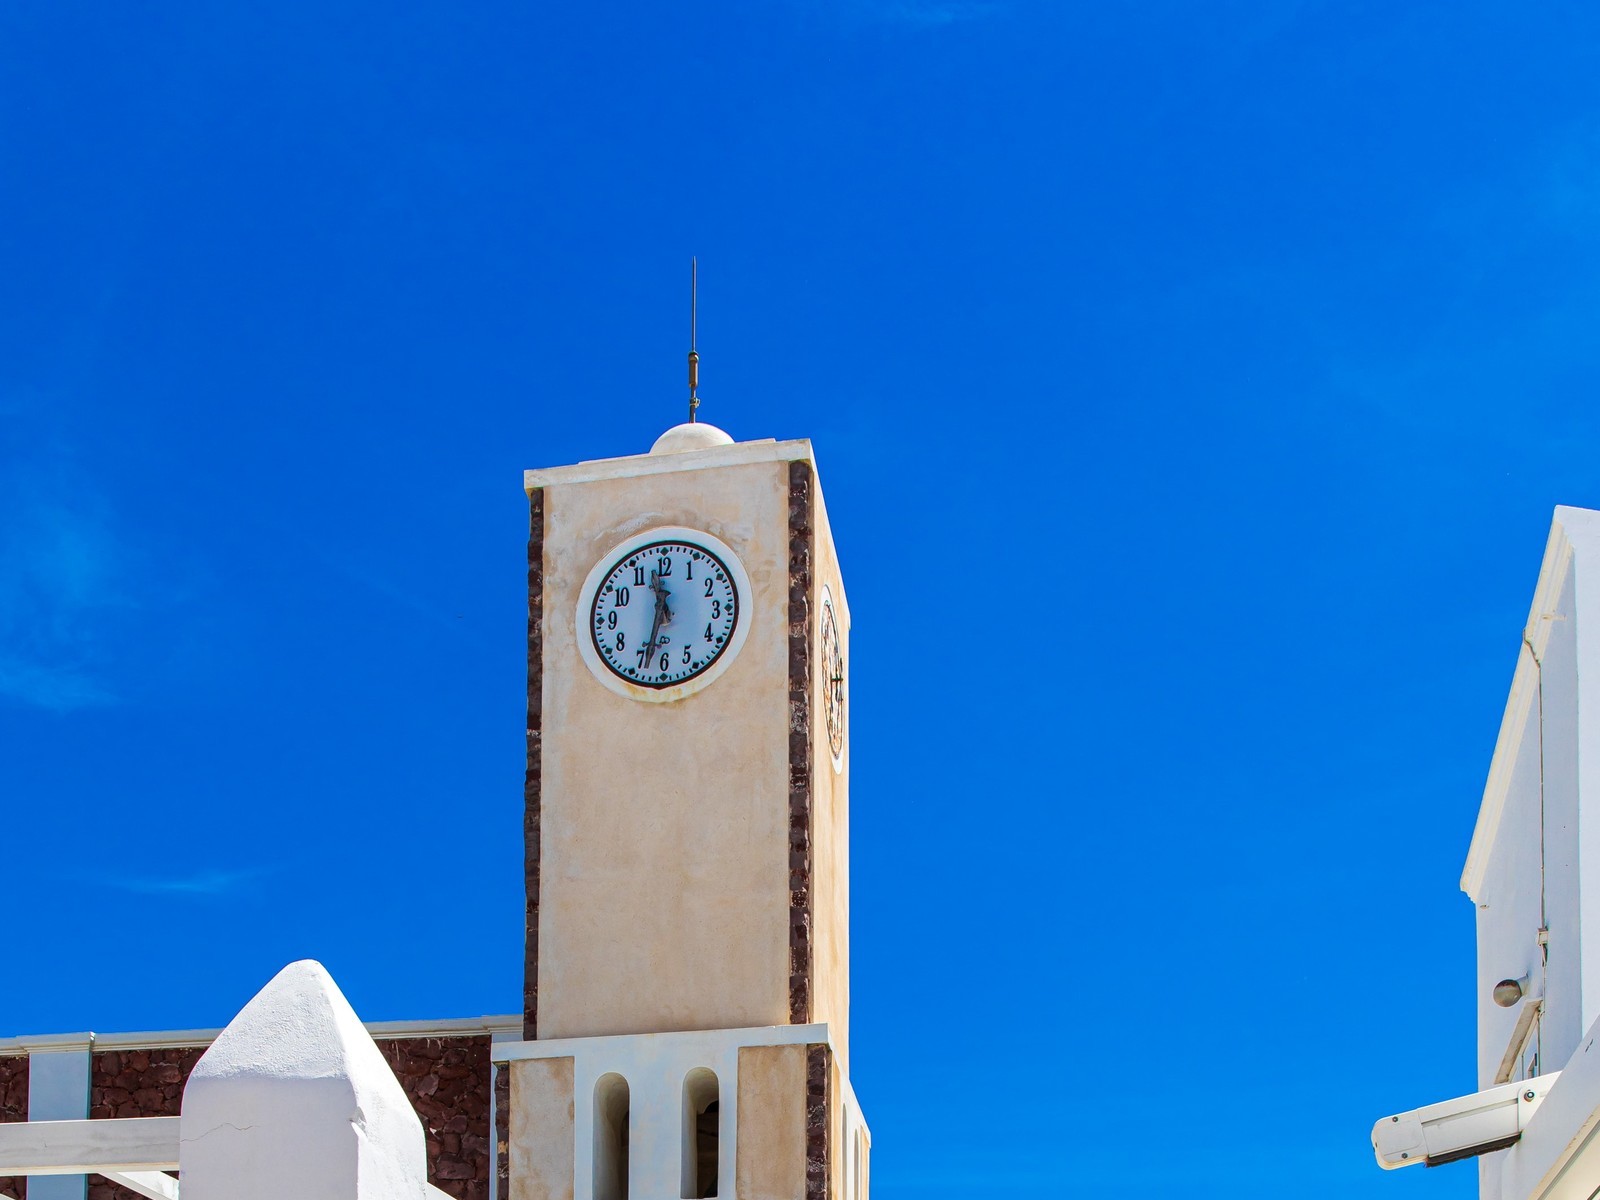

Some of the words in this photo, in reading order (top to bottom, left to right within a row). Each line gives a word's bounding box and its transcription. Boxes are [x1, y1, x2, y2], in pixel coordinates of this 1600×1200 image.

[633, 566, 645, 586] 11
[657, 557, 672, 577] 12
[686, 561, 693, 580] 1
[614, 587, 630, 607] 10
[704, 578, 714, 597] 2
[711, 600, 721, 619] 3
[608, 611, 617, 630] 9
[616, 632, 625, 651] 8
[704, 623, 713, 642] 4
[636, 650, 645, 669] 7
[660, 653, 669, 671] 6
[682, 645, 691, 664] 5
